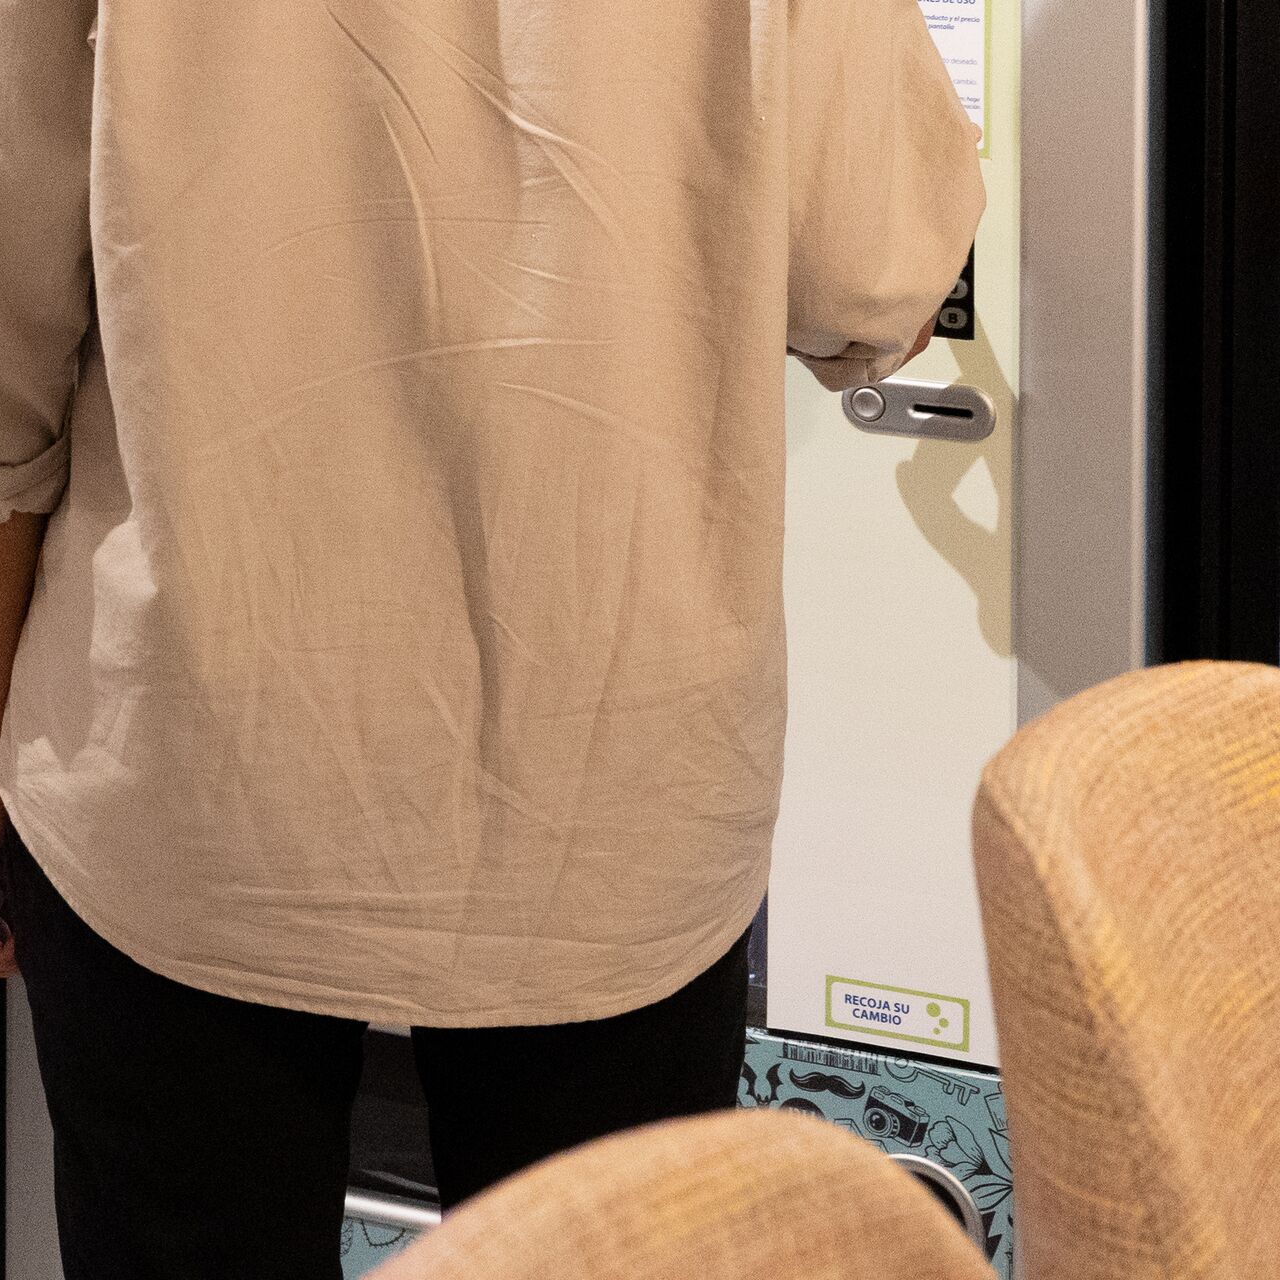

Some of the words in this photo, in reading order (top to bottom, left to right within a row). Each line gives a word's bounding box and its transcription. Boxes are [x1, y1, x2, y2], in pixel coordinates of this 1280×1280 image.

[948, 312, 958, 324] B
[844, 993, 891, 1012] RECOJA
[893, 1002, 910, 1015] SU
[852, 1008, 902, 1026] CAMBIO
